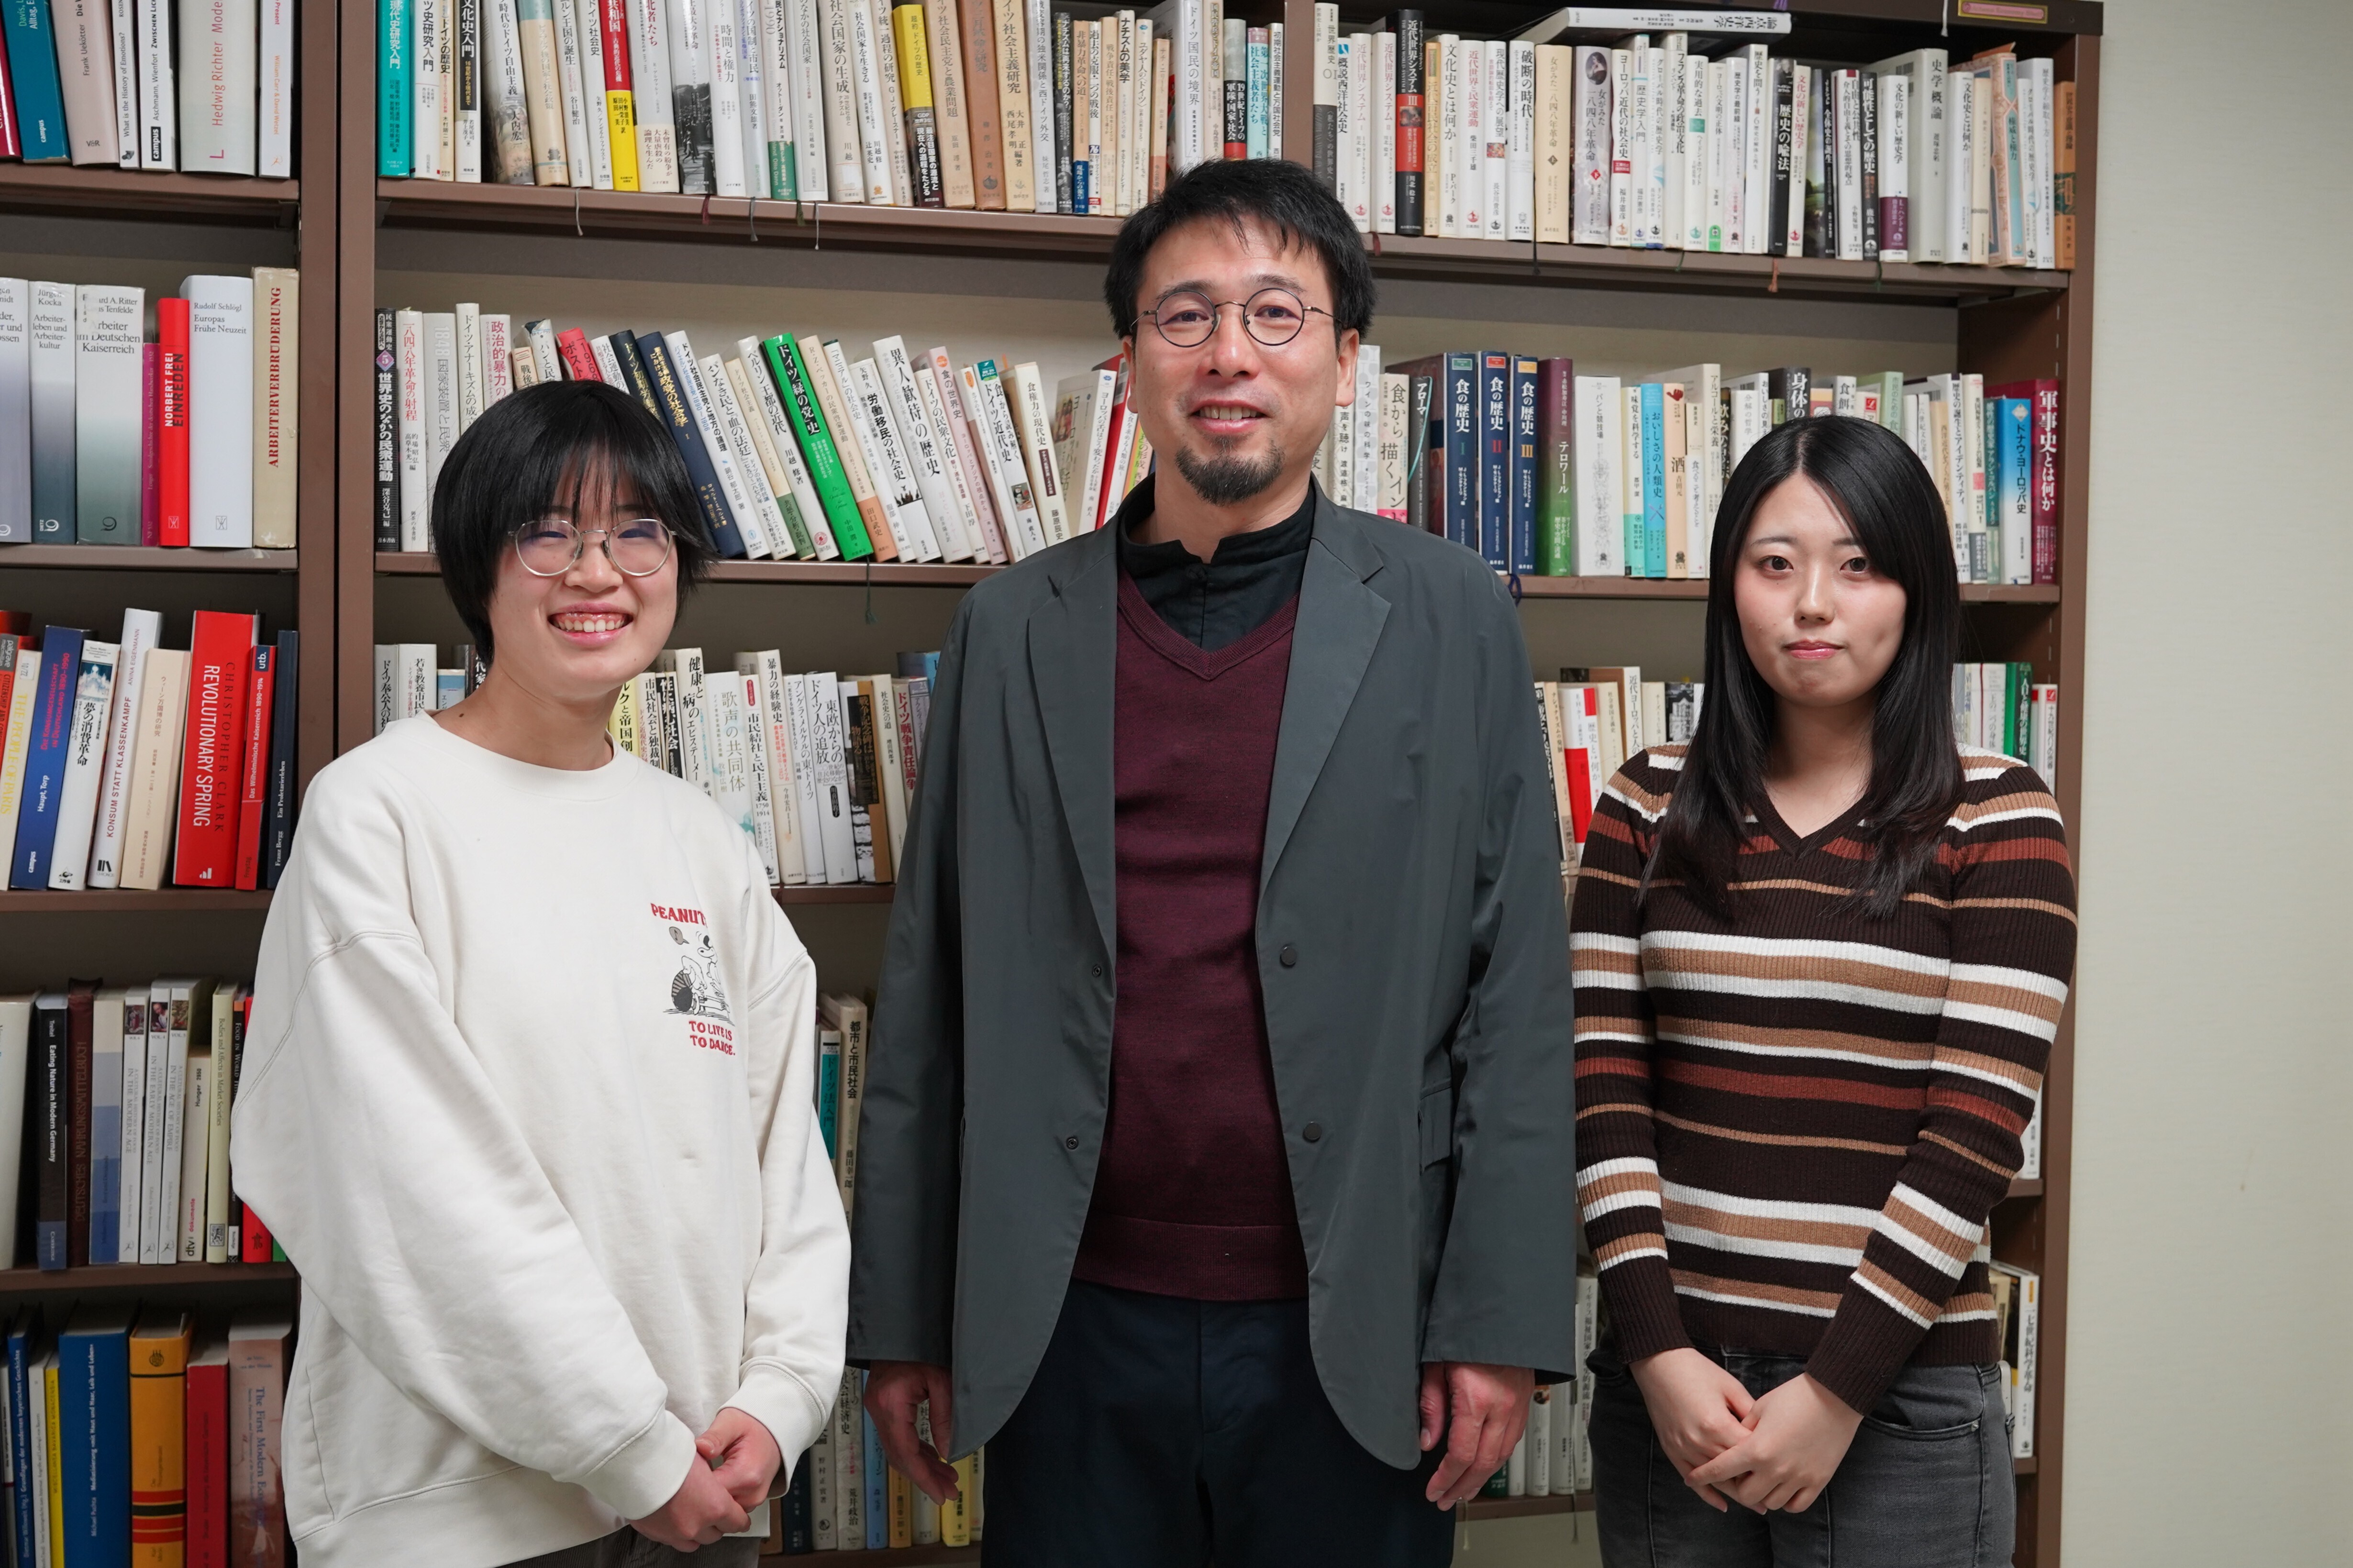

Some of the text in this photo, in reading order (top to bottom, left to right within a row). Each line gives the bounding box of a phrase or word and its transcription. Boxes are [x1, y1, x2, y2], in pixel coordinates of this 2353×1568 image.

[80, 24, 89, 54] Uekötter
[1119, 18, 1130, 84] ナチズムの美学
[1188, 7, 1199, 105] ドイツ国民の境界
[122, 76, 130, 99] History
[151, 54, 160, 121] Aschmann, Wienfort
[211, 41, 225, 126] Hedwig Richter
[1356, 44, 1367, 122] 近代世界システム
[1384, 44, 1393, 121] 近代世界システム
[1444, 44, 1457, 141] 文化史とは何か
[1468, 51, 1479, 128] 近代世界と民衆運動
[1521, 50, 1532, 119] 破断の時代
[1619, 55, 1629, 158] ヨーロッパ近代の社会史
[38, 298, 62, 307] Kocka
[105, 306, 133, 315] Tenfelde
[119, 298, 138, 306] Ritter
[194, 315, 225, 323] Europas
[218, 303, 242, 311] Schlögl
[33, 323, 52, 332] leben
[39, 341, 60, 350] kultur
[82, 343, 134, 354] Kaiserreich
[194, 324, 246, 334] Frühe Neuzeit
[165, 353, 173, 427] NORBERT FREI
[173, 353, 183, 427] EINREDEN
[941, 370, 963, 419] 食の世界史
[1455, 379, 1470, 433] 食の歴史
[1489, 376, 1504, 431] 食の歴史
[1521, 382, 1535, 435] 食の歴史
[1558, 441, 1570, 494] テロワール
[1651, 412, 1663, 498] おいしさの人類史
[2038, 390, 2058, 511] 軍事史とは何か
[131, 628, 141, 665] EIGENMANN
[258, 651, 266, 669] utb.
[192, 664, 221, 827] REVOLUTIONARY SPRING
[253, 708, 262, 740] Kaiserreich
[106, 696, 132, 838] KONSUM STATT KLASSENKAMPF
[214, 662, 235, 832] CHRISTOPHER CLARK
[250, 741, 260, 785] Wilhelminische
[37, 793, 46, 812] Haupt,
[28, 851, 36, 872] campus
[650, 903, 707, 926] PEANUT
[689, 1021, 733, 1041] TO LIVE IS
[689, 1035, 707, 1048] TO
[49, 1045, 57, 1067] Eating
[194, 1084, 202, 1107] Hunger
[48, 1130, 56, 1162] Germany
[185, 1240, 195, 1257] dtv
[256, 1387, 266, 1477] The First Modern
